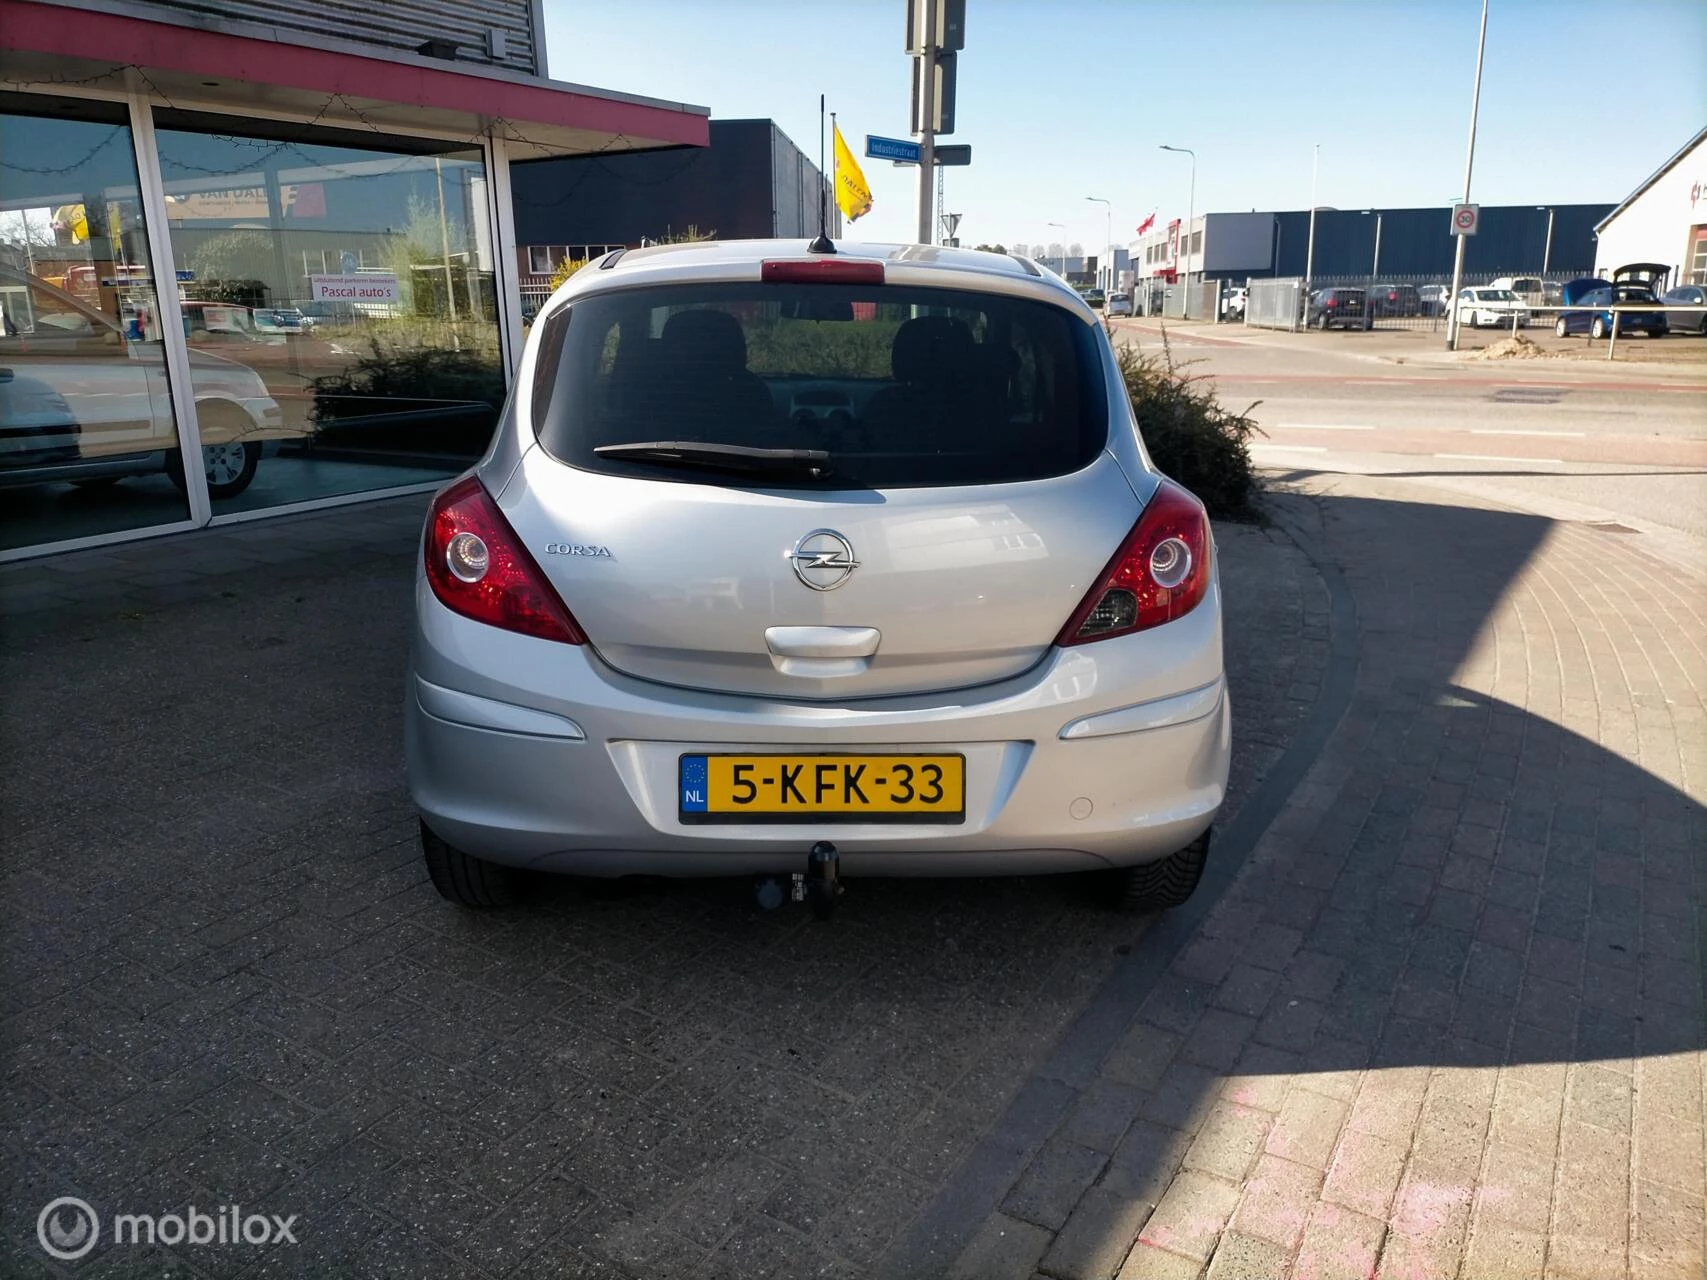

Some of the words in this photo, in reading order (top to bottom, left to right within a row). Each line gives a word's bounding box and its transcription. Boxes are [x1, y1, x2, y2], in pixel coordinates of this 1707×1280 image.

[1460, 215, 1471, 224] 30
[321, 286, 356, 297] Pascal
[359, 287, 391, 297] auto's
[545, 543, 611, 557] CORSA
[731, 764, 944, 804] 5-KFK-33
[685, 790, 704, 803] NL
